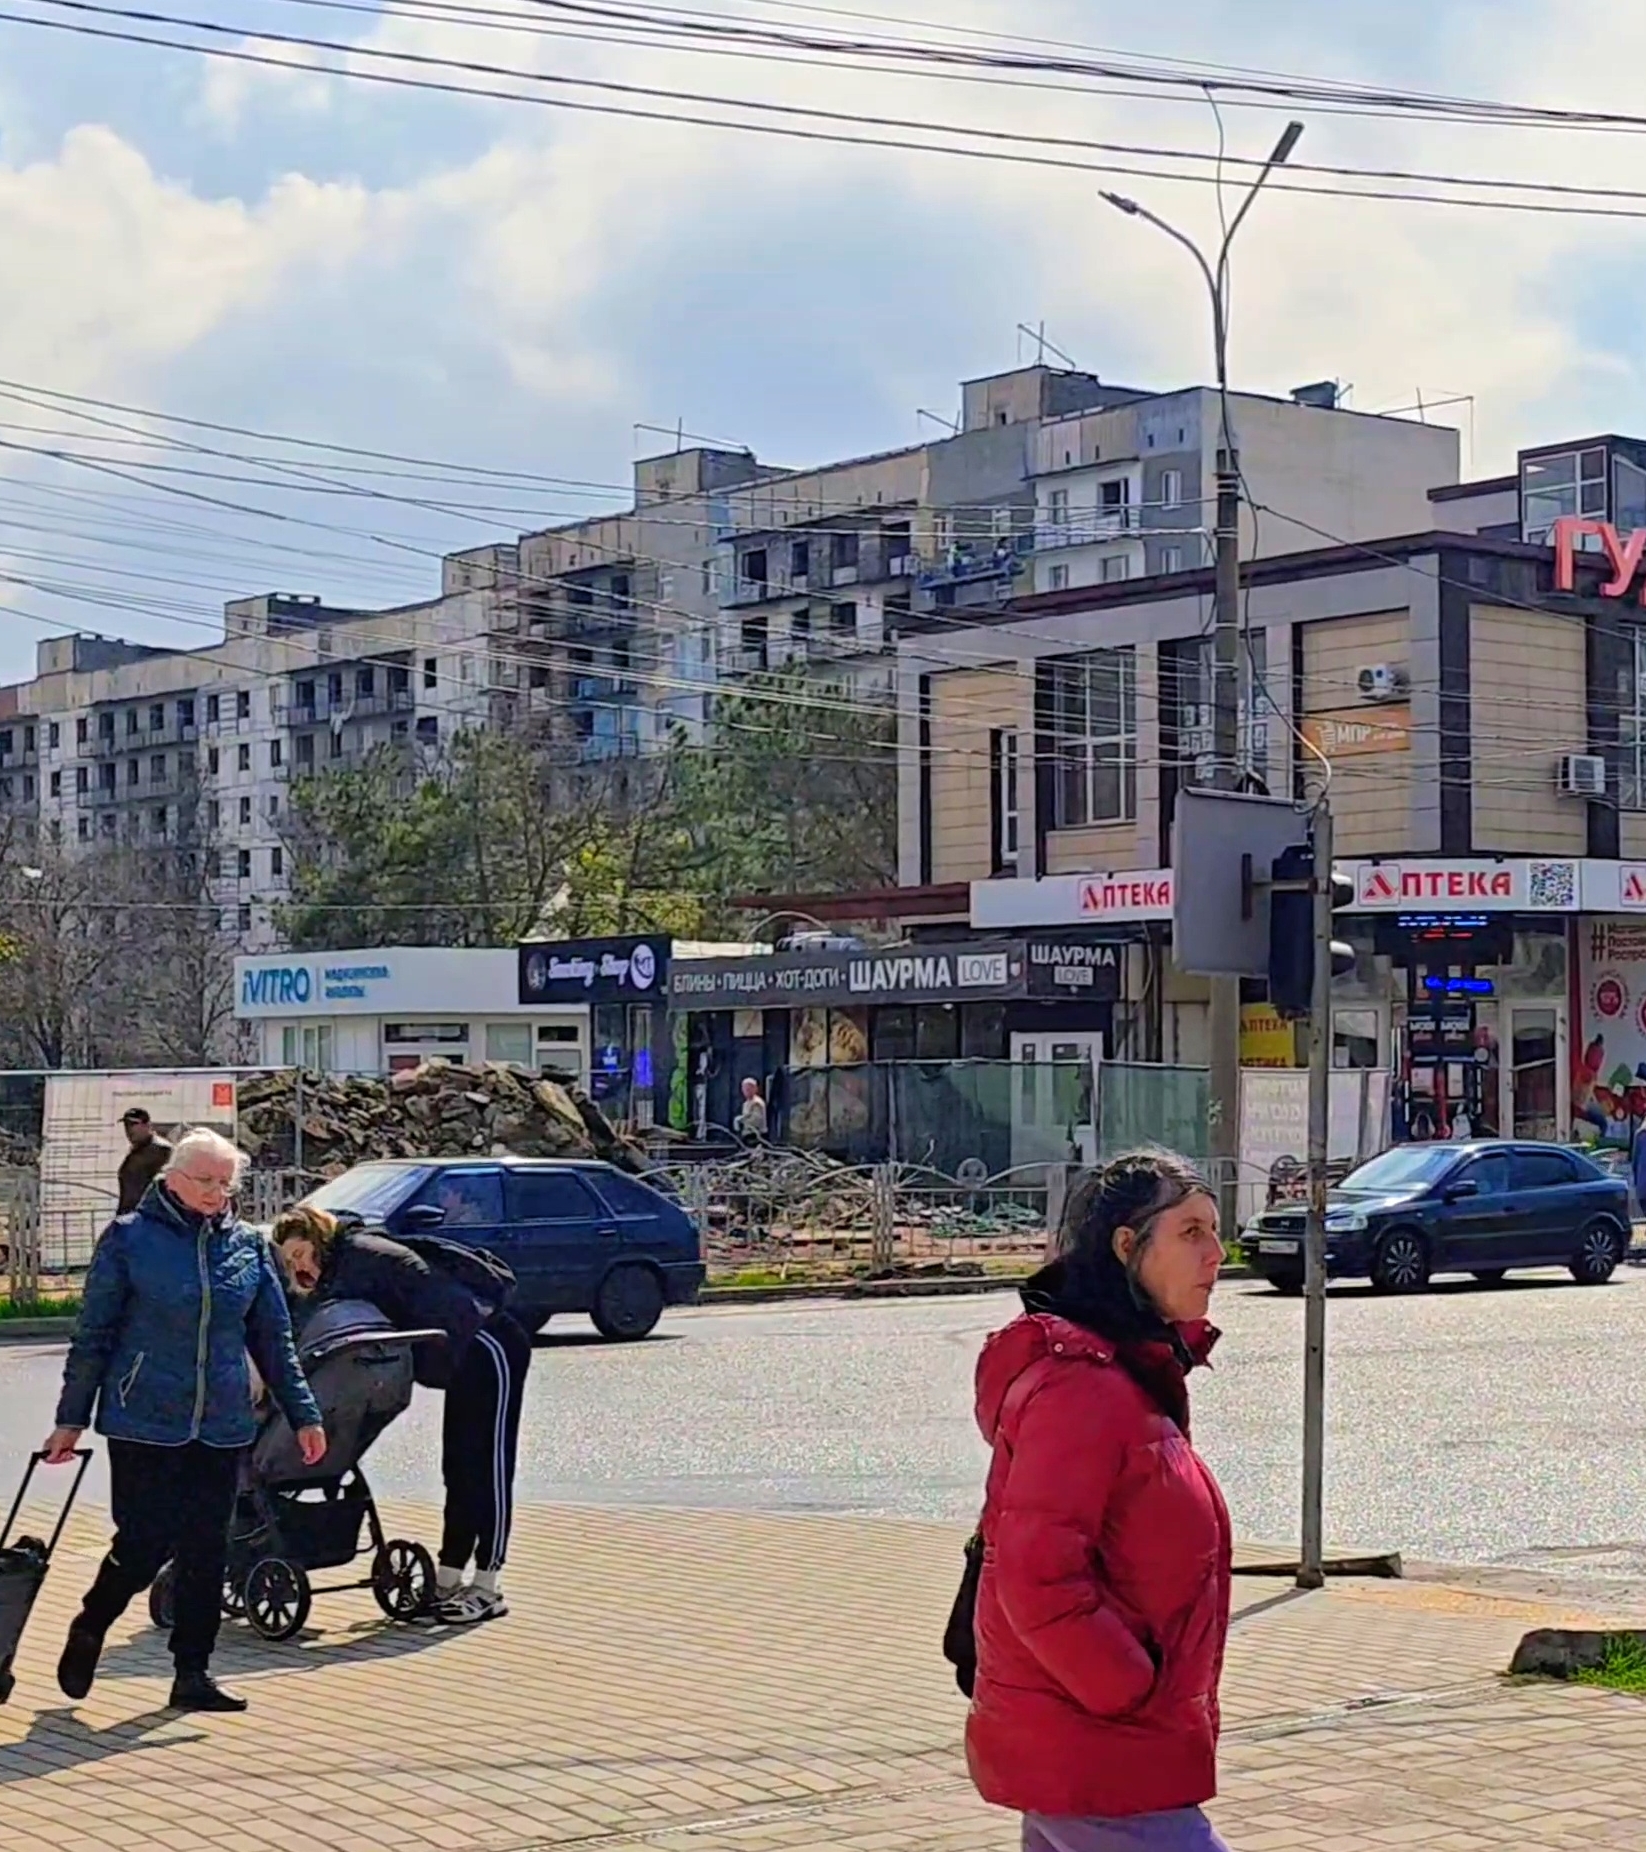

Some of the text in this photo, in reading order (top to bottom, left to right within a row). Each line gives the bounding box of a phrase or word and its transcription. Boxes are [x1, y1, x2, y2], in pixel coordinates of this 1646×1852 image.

[1337, 724, 1371, 743] МПР
[1083, 881, 1170, 910] АПТЕКА
[1365, 872, 1511, 897] АПТЕКА
[1031, 944, 1115, 967] ШАУРМА
[850, 956, 951, 993] ШАУРМА
[961, 961, 1003, 982] LOVE
[1057, 967, 1090, 983] LOVE
